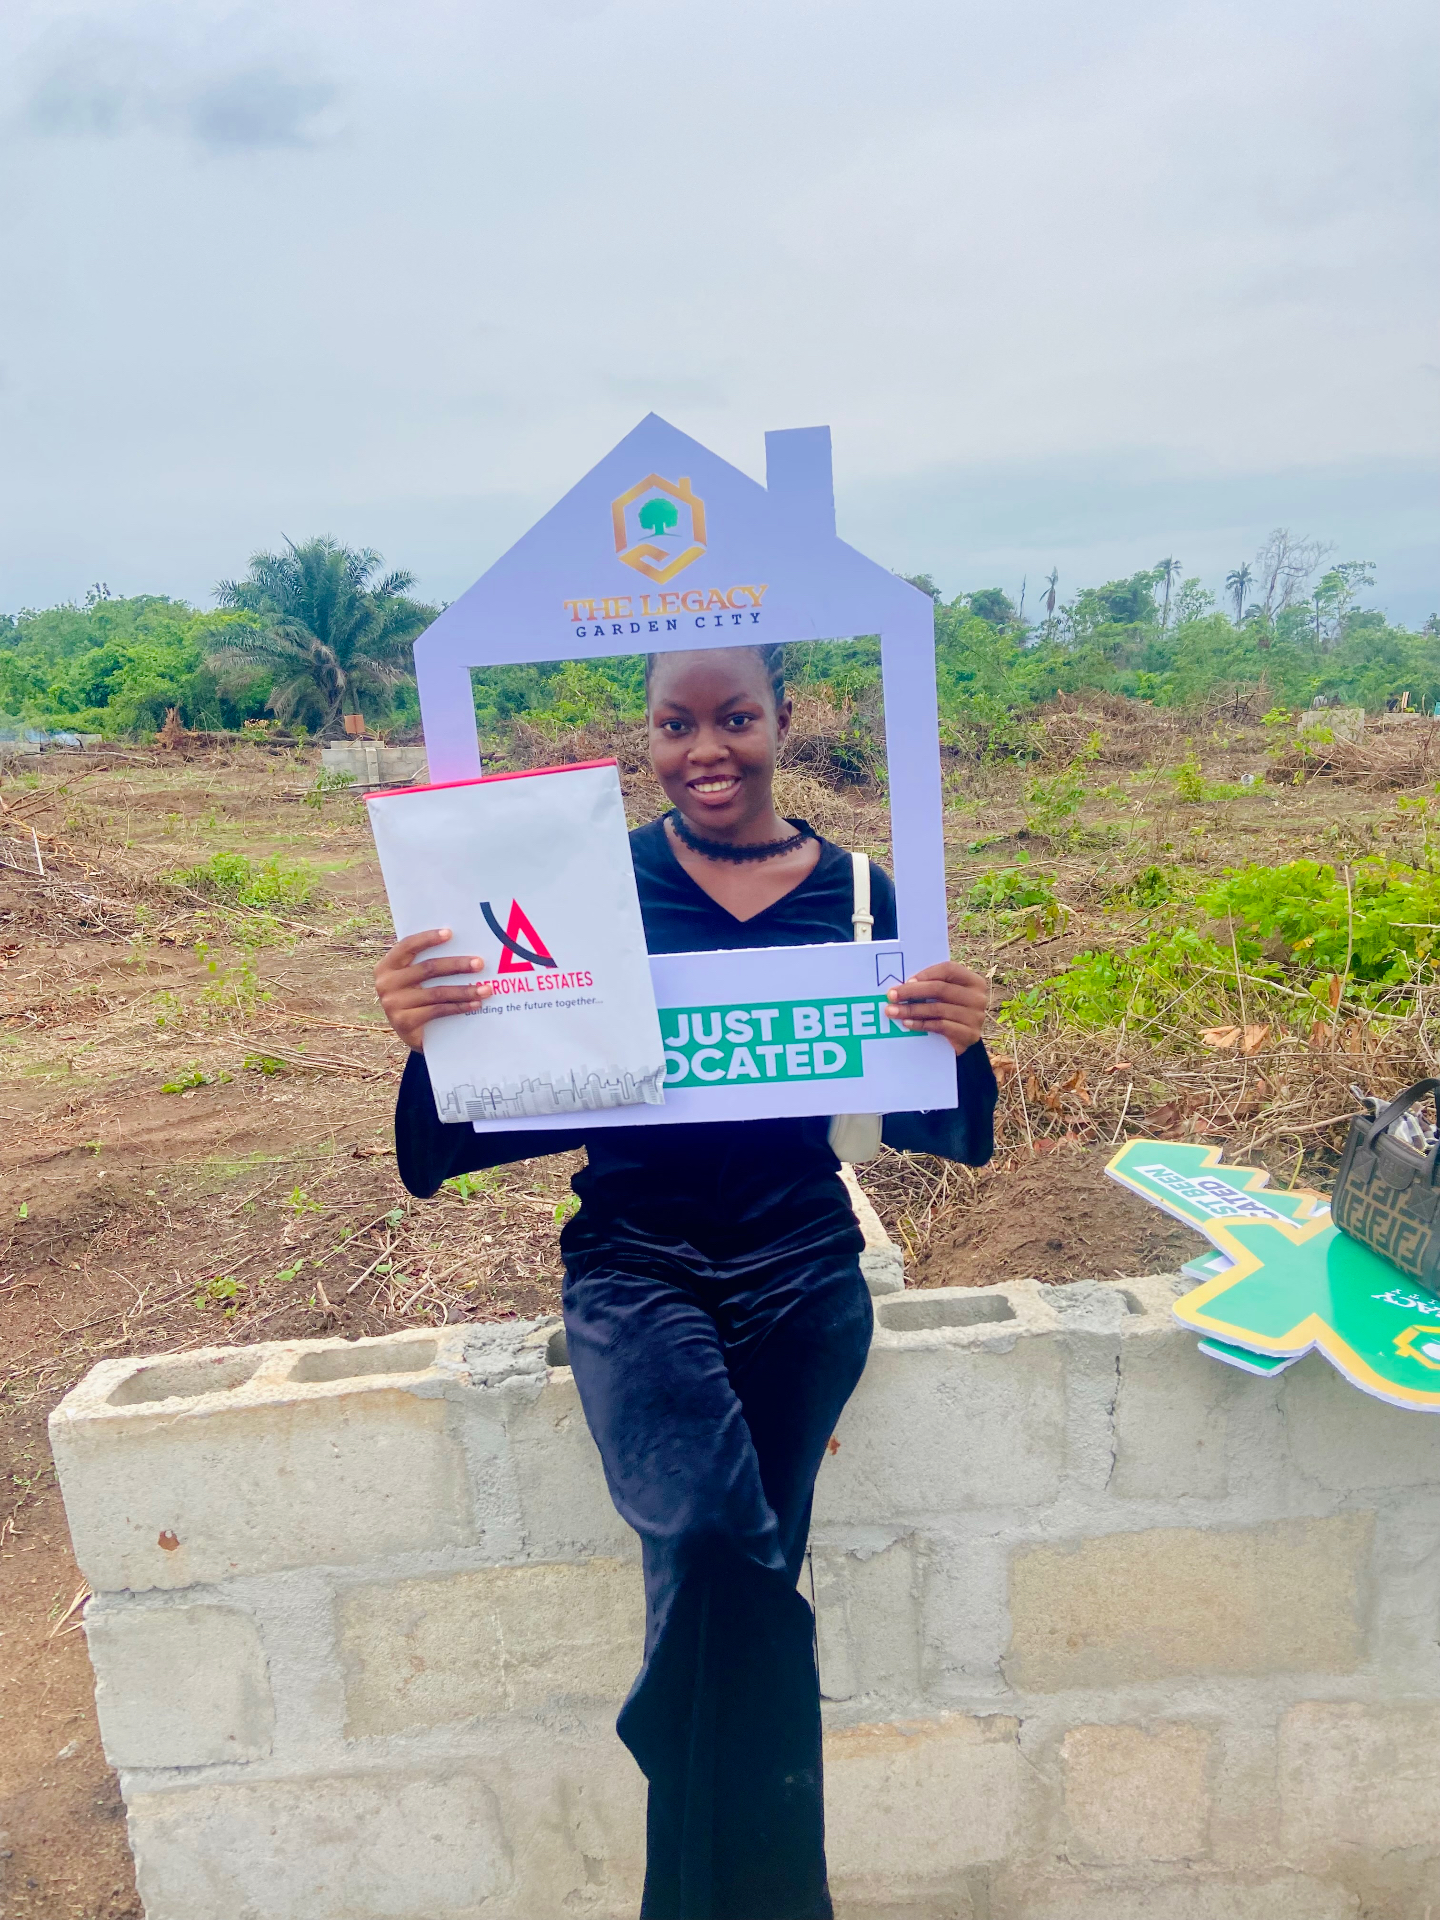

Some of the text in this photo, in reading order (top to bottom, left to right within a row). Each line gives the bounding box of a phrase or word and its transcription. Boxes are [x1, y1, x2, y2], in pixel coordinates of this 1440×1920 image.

[563, 584, 769, 622] THE LEGACY
[576, 612, 761, 638] GARDEN CITY
[468, 971, 594, 997] ROYAL ESTATES
[506, 1003, 522, 1012] the
[524, 1001, 553, 1011] future
[664, 1008, 780, 1048] JUST
[1144, 1167, 1210, 1198] BEEN
